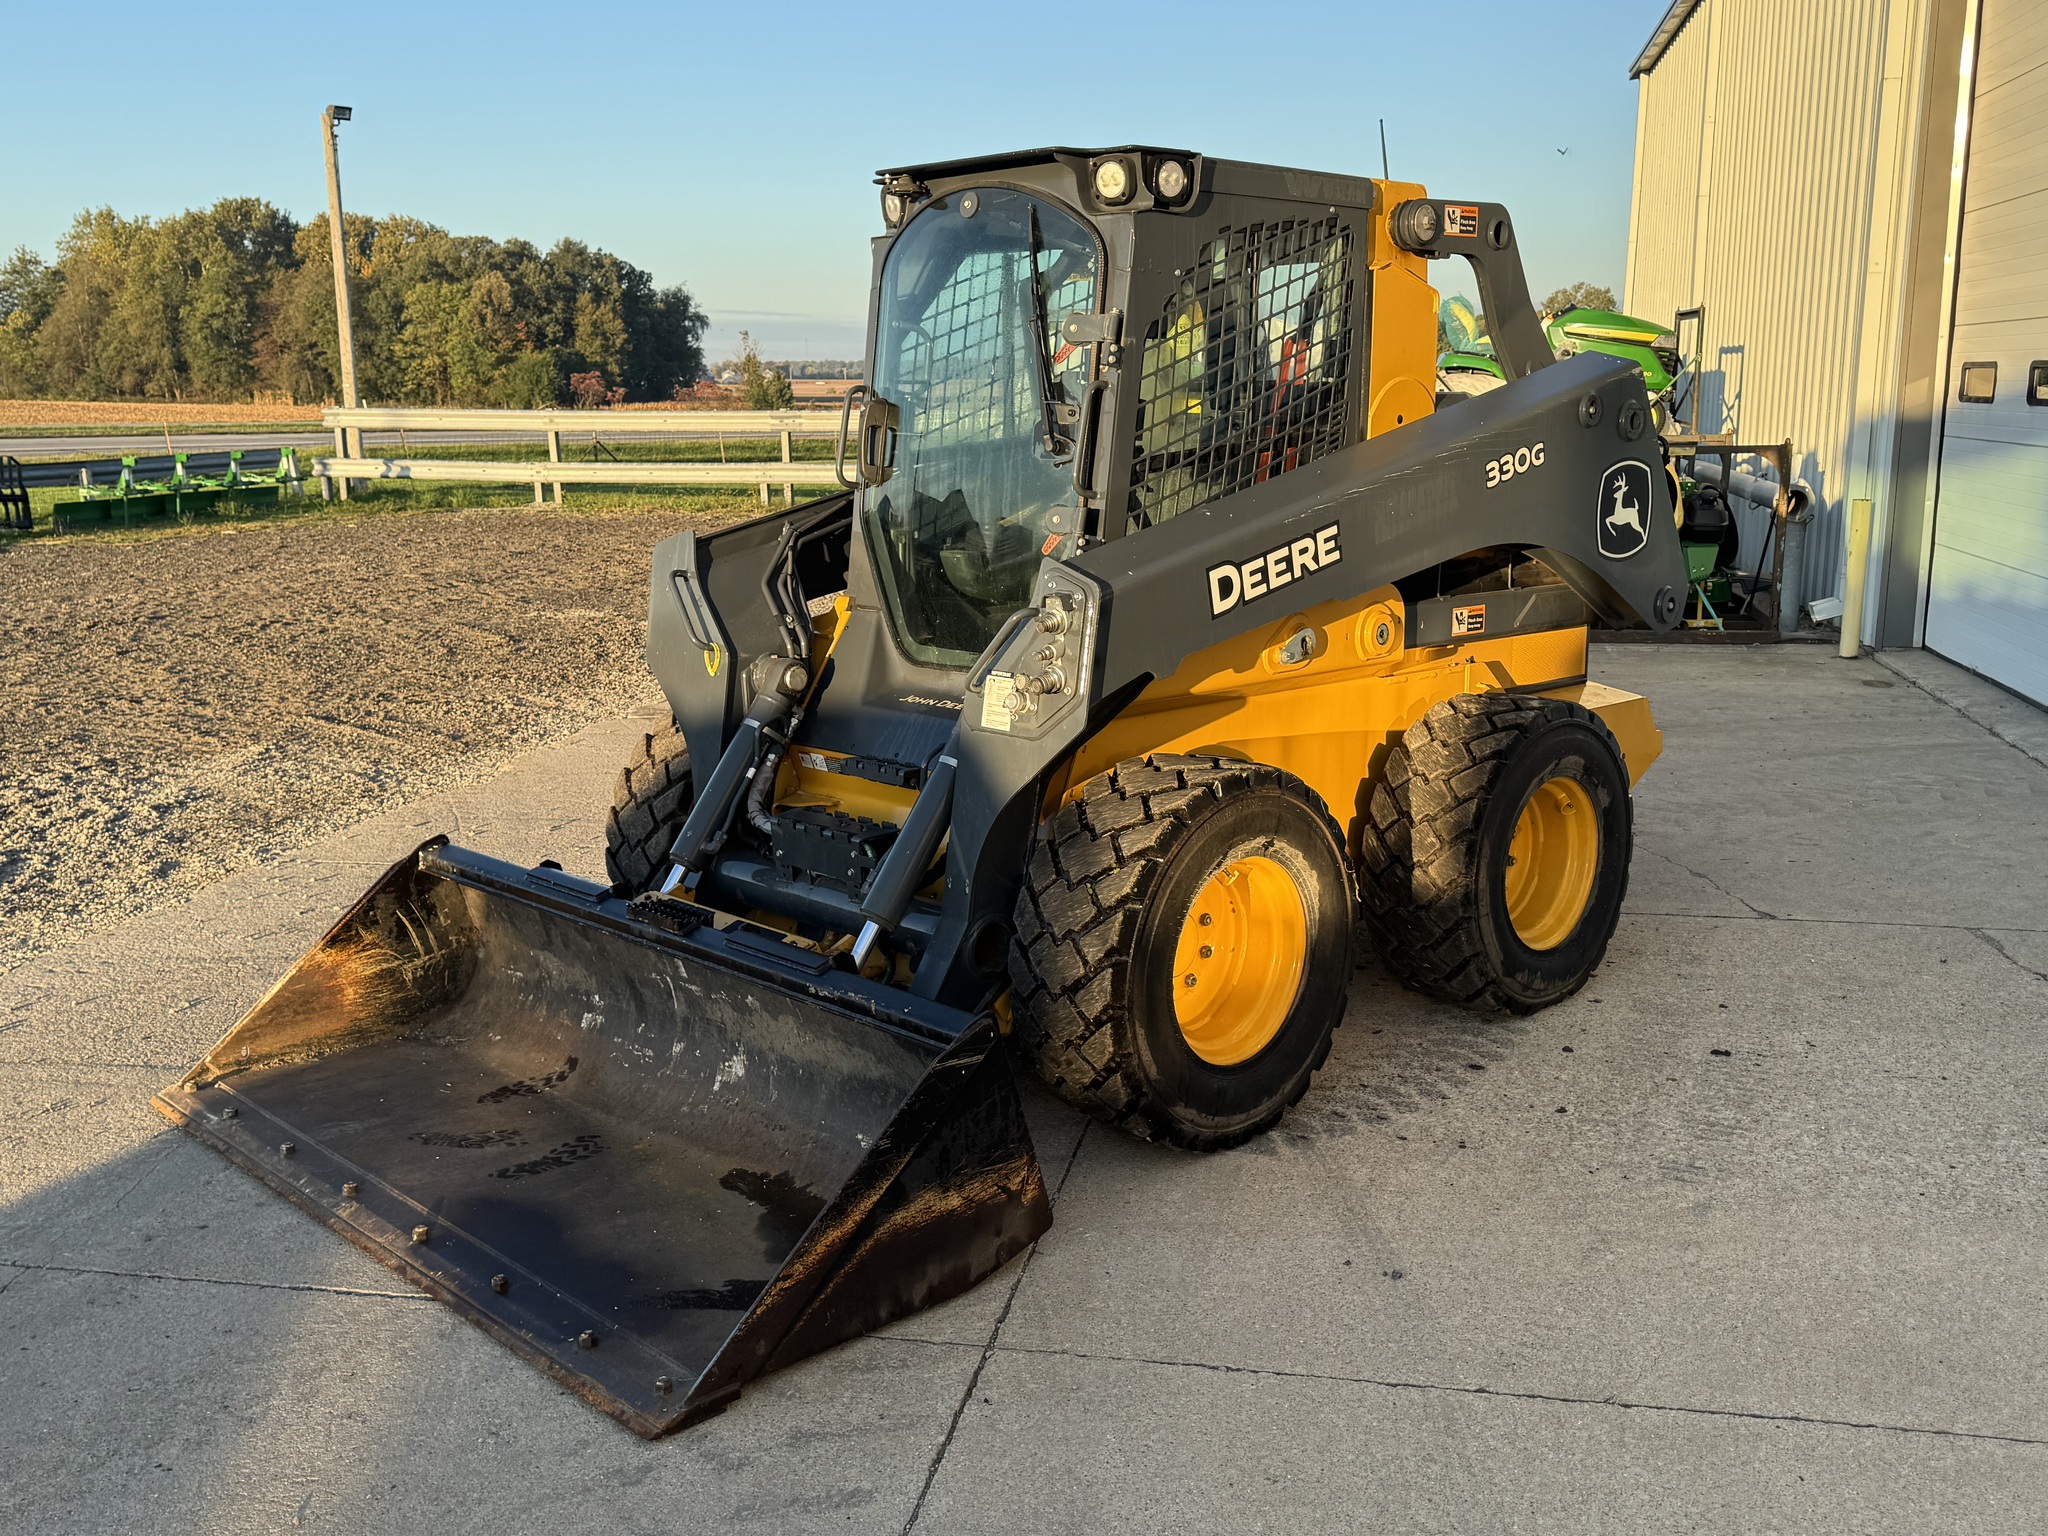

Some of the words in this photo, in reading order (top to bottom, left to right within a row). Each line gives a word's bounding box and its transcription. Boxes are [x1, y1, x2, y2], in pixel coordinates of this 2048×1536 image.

[1486, 442, 1545, 488] 330G
[1209, 524, 1341, 615] DEERE
[898, 694, 939, 706] JOHN
[935, 699, 965, 710] DEE
